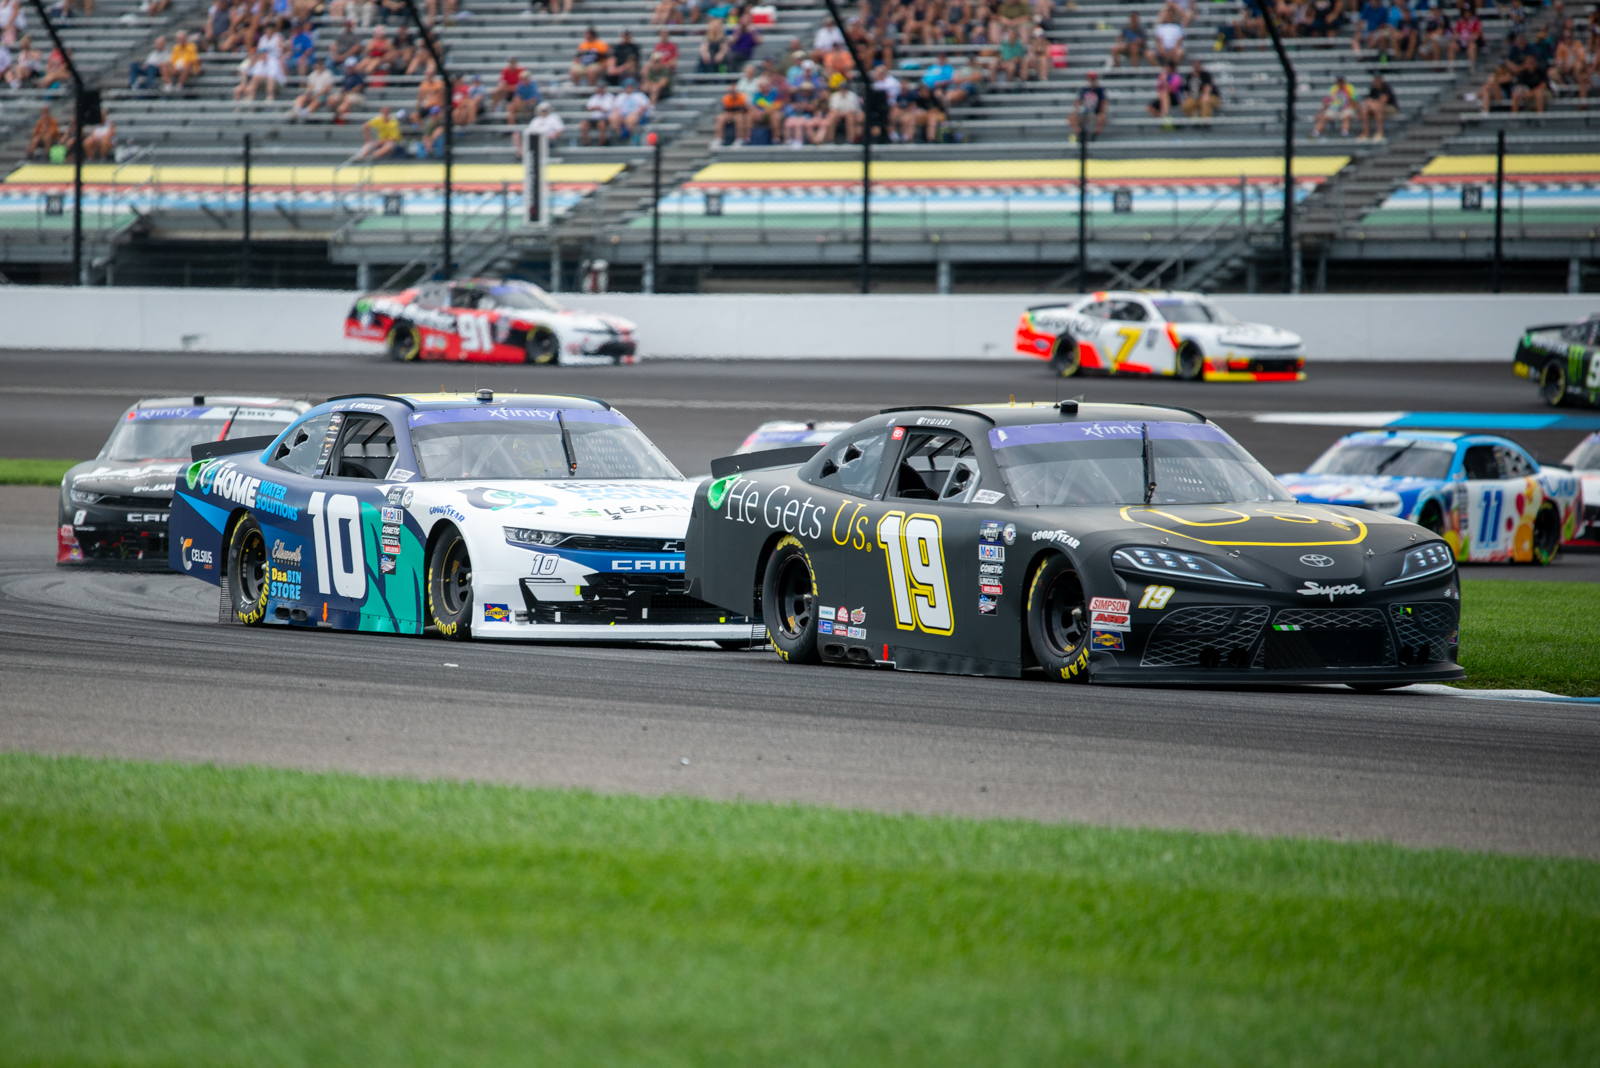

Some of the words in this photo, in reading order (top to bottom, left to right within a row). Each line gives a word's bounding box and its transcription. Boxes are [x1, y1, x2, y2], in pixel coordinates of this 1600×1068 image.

[457, 314, 493, 351] 91
[1115, 327, 1142, 363] 7
[139, 407, 192, 419] xfinity
[487, 407, 555, 420] xfinity
[212, 467, 261, 508] HOME
[259, 480, 287, 500] WATER
[74, 510, 87, 526] 8
[383, 509, 396, 519] Mobil
[429, 504, 465, 523] GOODYEAR
[725, 479, 759, 524] He
[764, 485, 826, 539] Gets
[1479, 487, 1505, 545] 11
[382, 525, 400, 535] COMETIC
[1032, 529, 1080, 549] GOODYEAR
[307, 491, 366, 599] 10
[382, 538, 399, 546] LINCOLN
[980, 546, 996, 557] Mobil
[191, 549, 213, 563] CELSIUS
[531, 554, 560, 575] 10
[877, 510, 954, 636] 19
[980, 564, 1003, 574] COMETIC
[271, 581, 302, 600] STORE
[980, 577, 999, 585] LINCOLN
[1138, 585, 1175, 609] 19
[1297, 581, 1365, 602] Supra
[1092, 599, 1128, 612] SIMPSON
[1094, 613, 1128, 624] ARP
